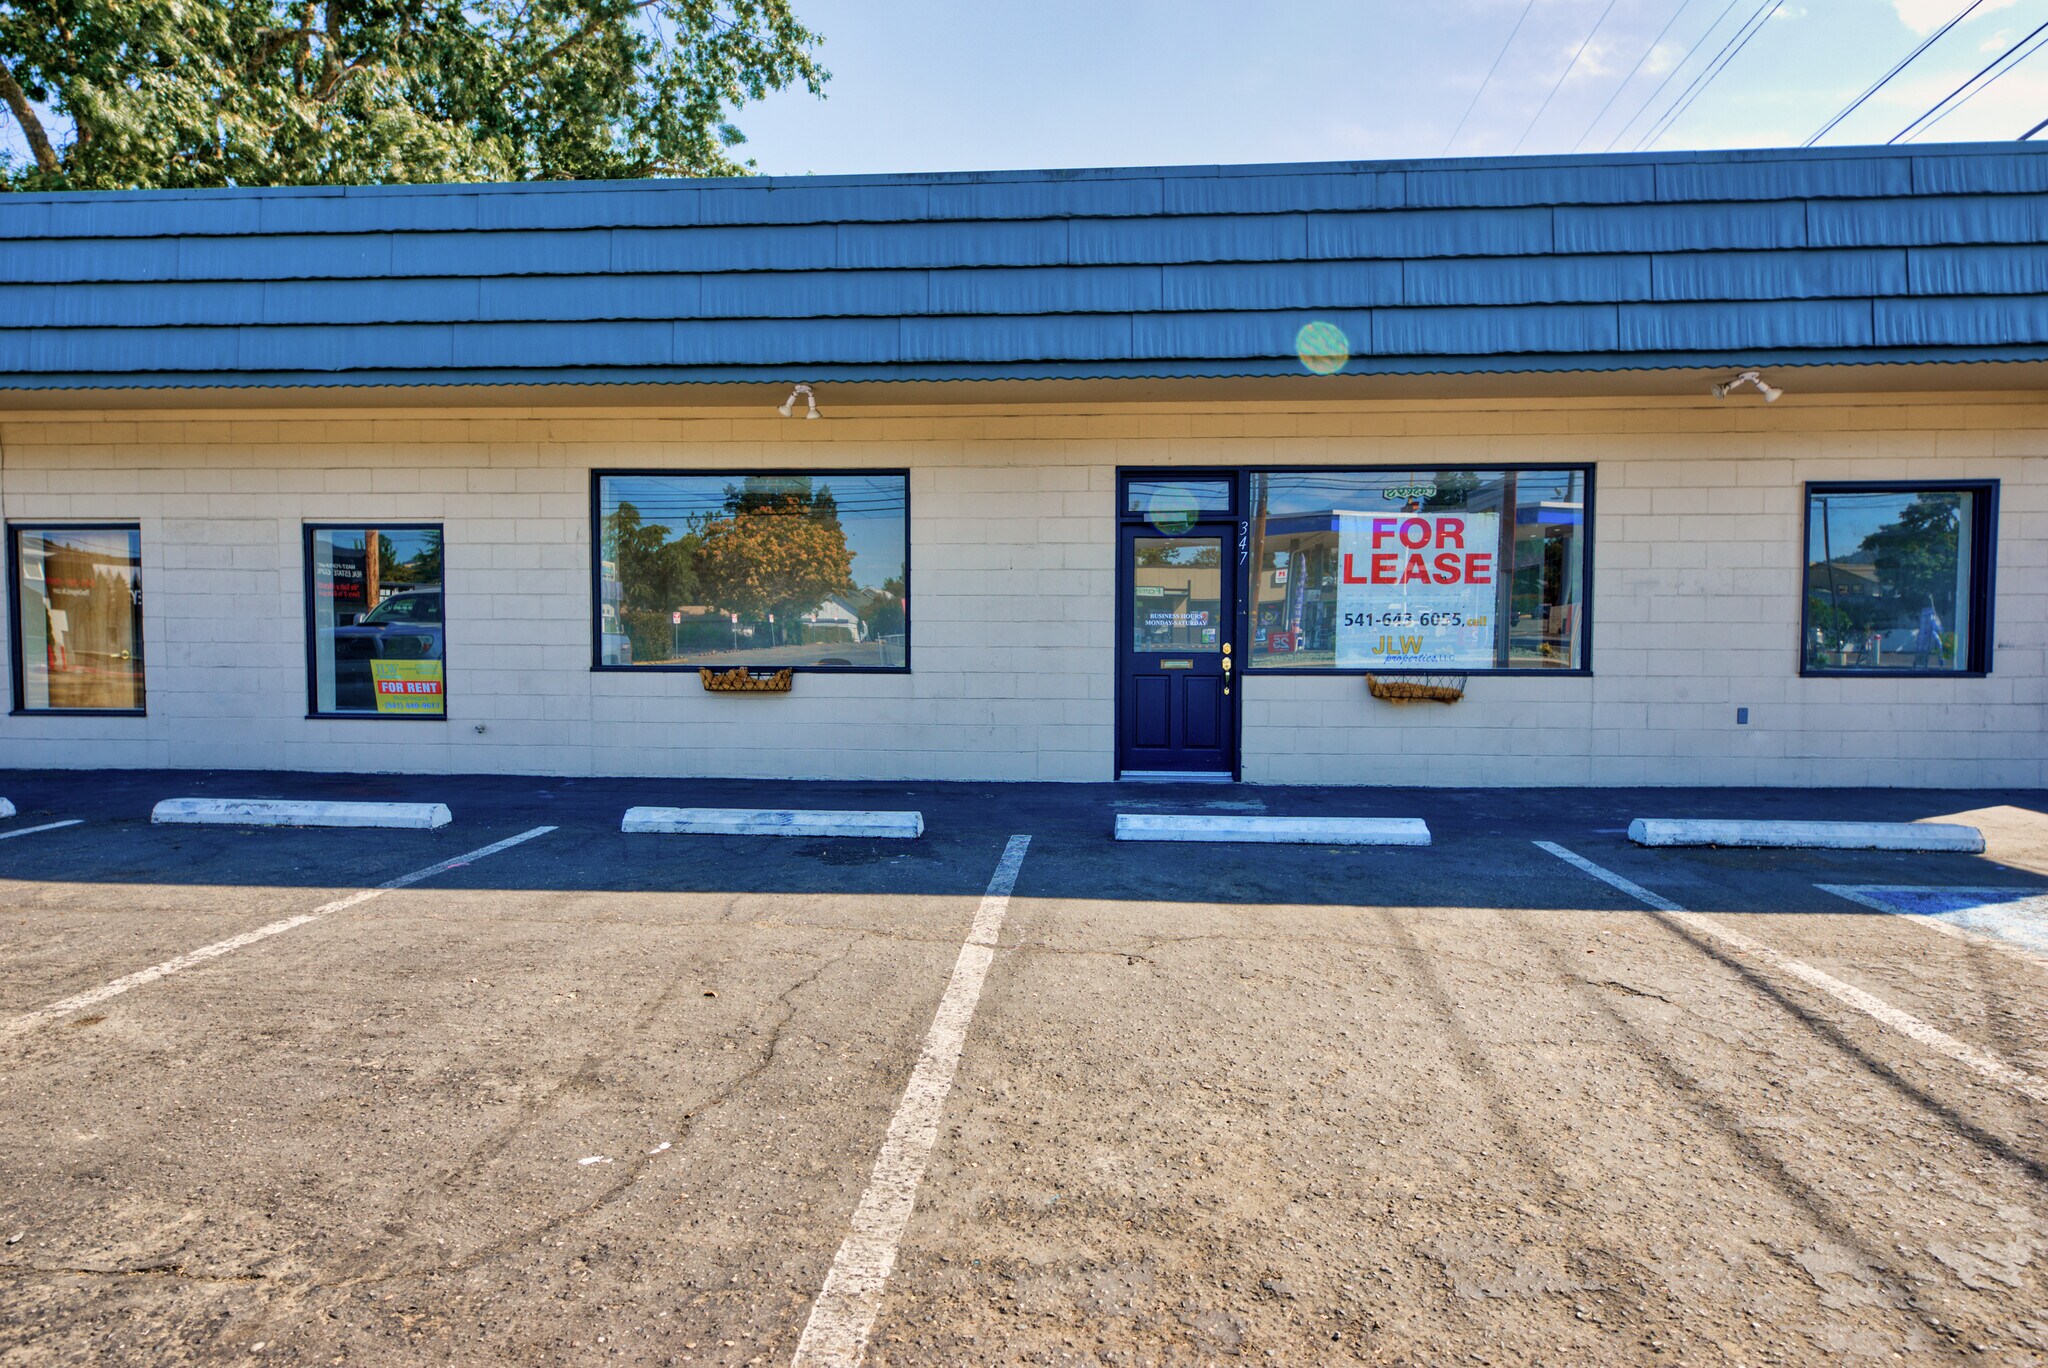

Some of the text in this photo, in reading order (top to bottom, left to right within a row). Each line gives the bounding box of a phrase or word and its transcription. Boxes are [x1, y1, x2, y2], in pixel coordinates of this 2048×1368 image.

[1238, 521, 1249, 566] 347
[1371, 517, 1465, 550] FOR
[1343, 553, 1492, 585] LEASE
[1466, 616, 1488, 627] cell
[1372, 635, 1424, 655] JLW
[375, 664, 399, 676] JLW
[381, 682, 437, 693] FOR RENT
